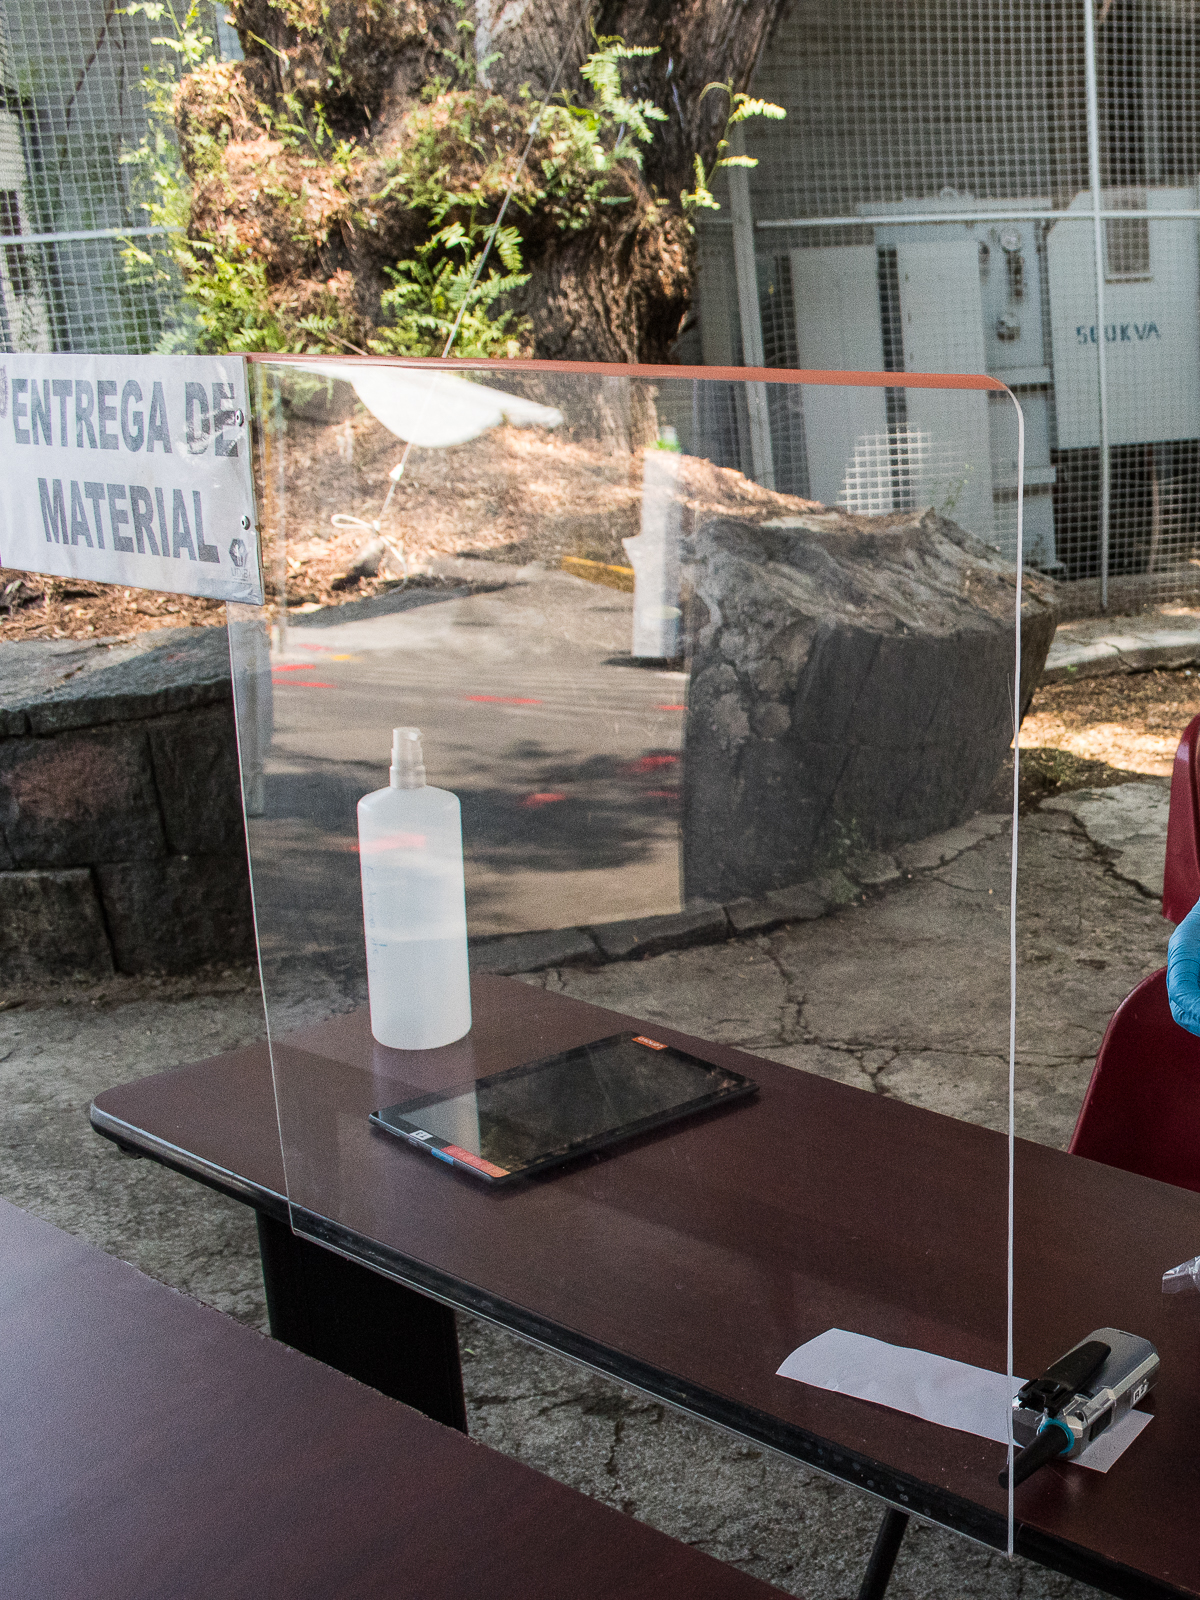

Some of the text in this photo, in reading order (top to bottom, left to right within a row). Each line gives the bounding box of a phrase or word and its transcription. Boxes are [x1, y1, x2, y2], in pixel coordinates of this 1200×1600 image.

[11, 378, 173, 454] ENTREGA
[184, 381, 239, 458] DE
[37, 477, 220, 563] MATERIAL
